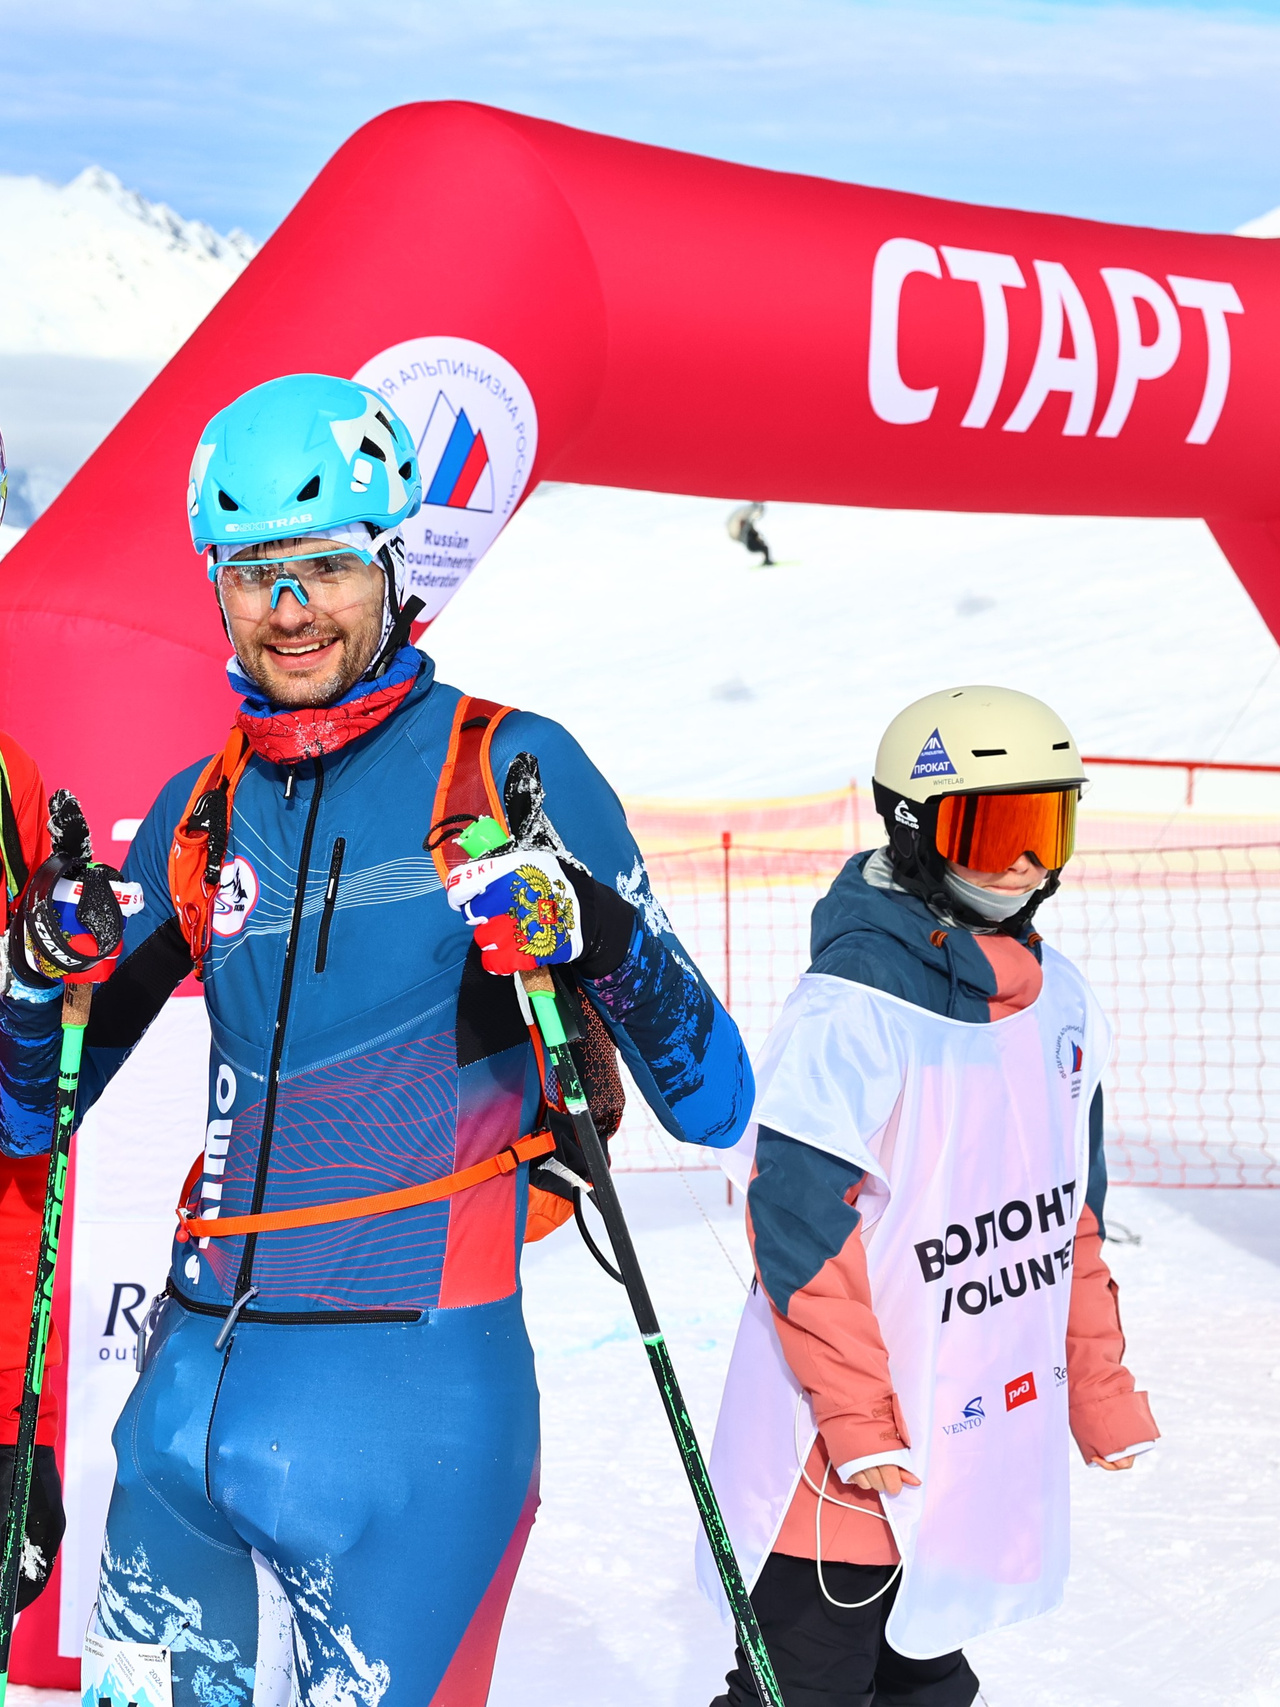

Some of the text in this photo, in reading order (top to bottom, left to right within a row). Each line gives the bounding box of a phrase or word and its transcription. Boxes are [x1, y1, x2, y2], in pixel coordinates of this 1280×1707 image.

[868, 237, 1244, 444] СТАРТ
[400, 359, 519, 422] АЛЬПИНИЗМА
[239, 513, 313, 532] SKITRAB
[423, 529, 470, 549] Russian
[410, 570, 460, 588] Federation
[914, 761, 951, 775] ПРОКАТ
[932, 777, 965, 786] WHITELAB
[942, 1417, 982, 1436] VENTO
[148, 1669, 163, 1687] 2024
